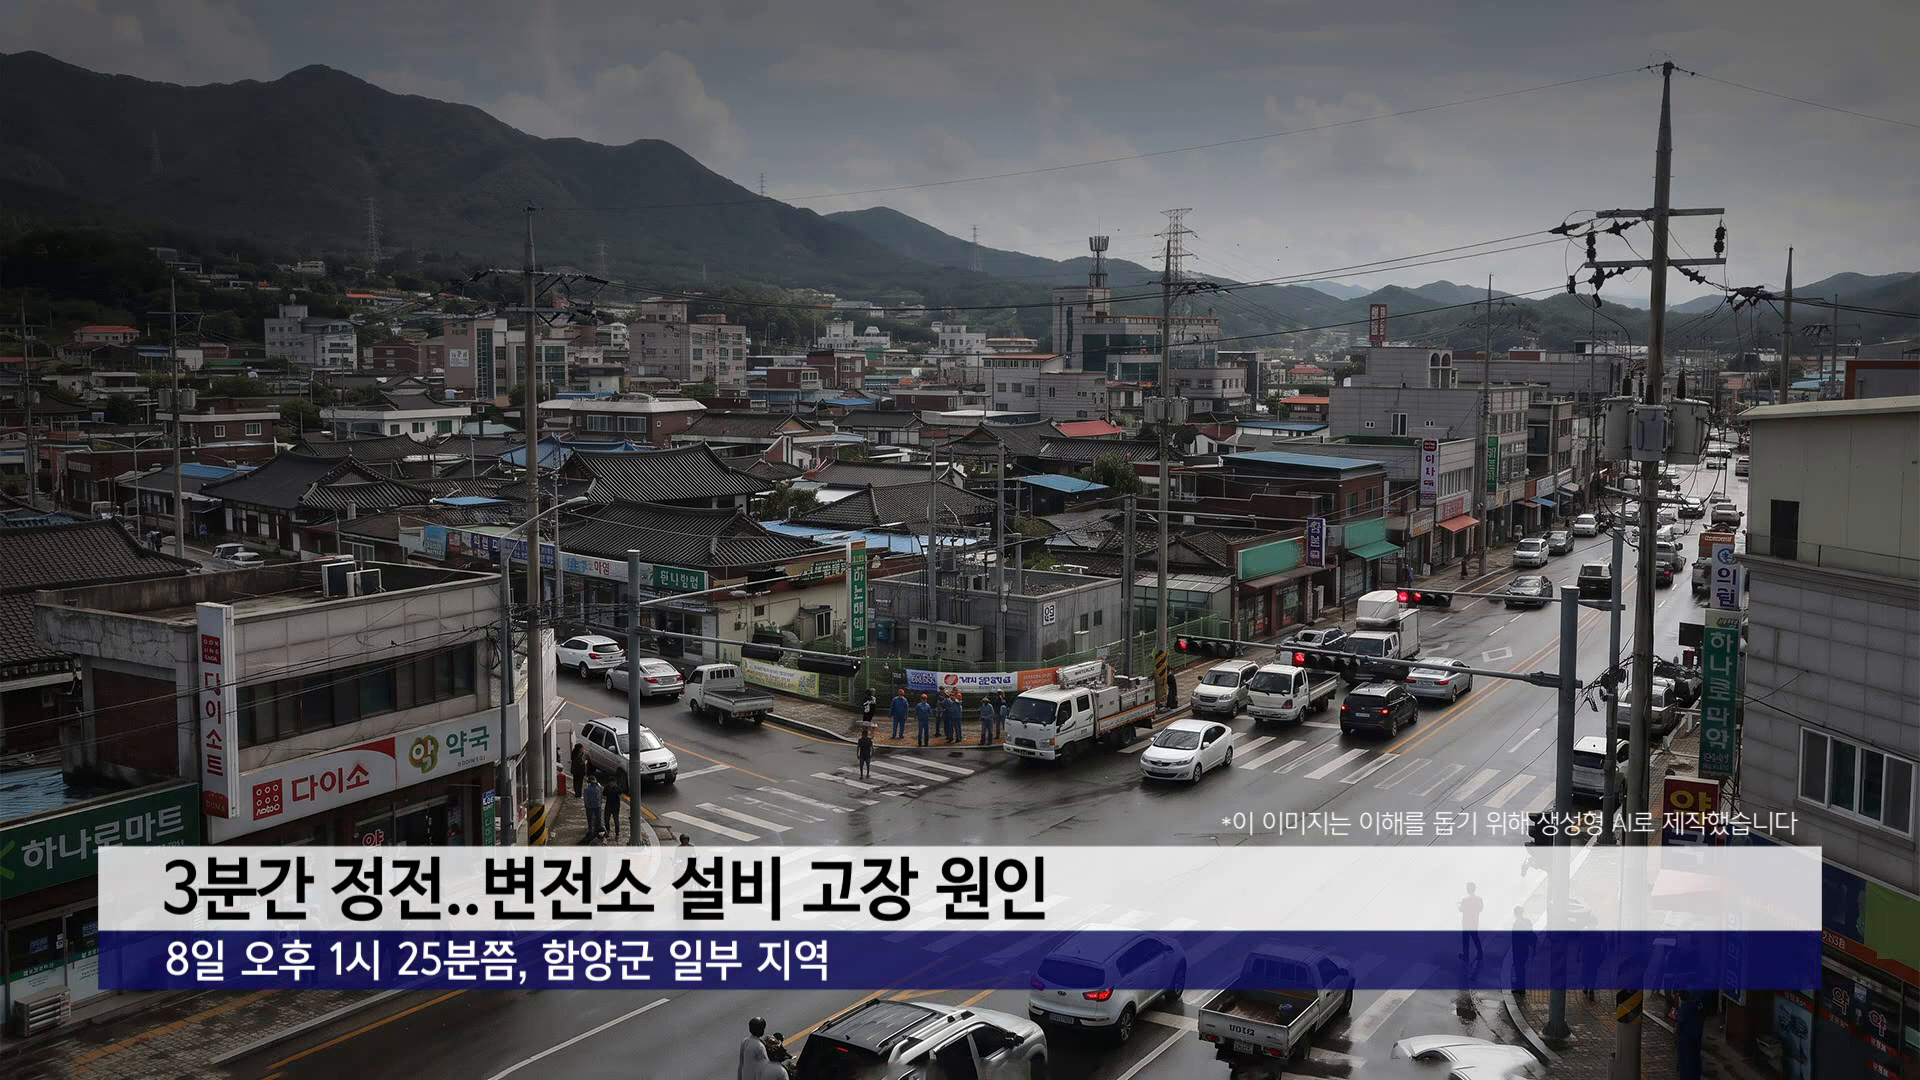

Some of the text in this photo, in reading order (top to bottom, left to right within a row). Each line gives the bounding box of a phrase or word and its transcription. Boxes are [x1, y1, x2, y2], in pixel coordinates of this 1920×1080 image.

[446, 725, 490, 758] 약국
[291, 764, 370, 802] 다이소
[21, 805, 184, 870] 하나로마트
